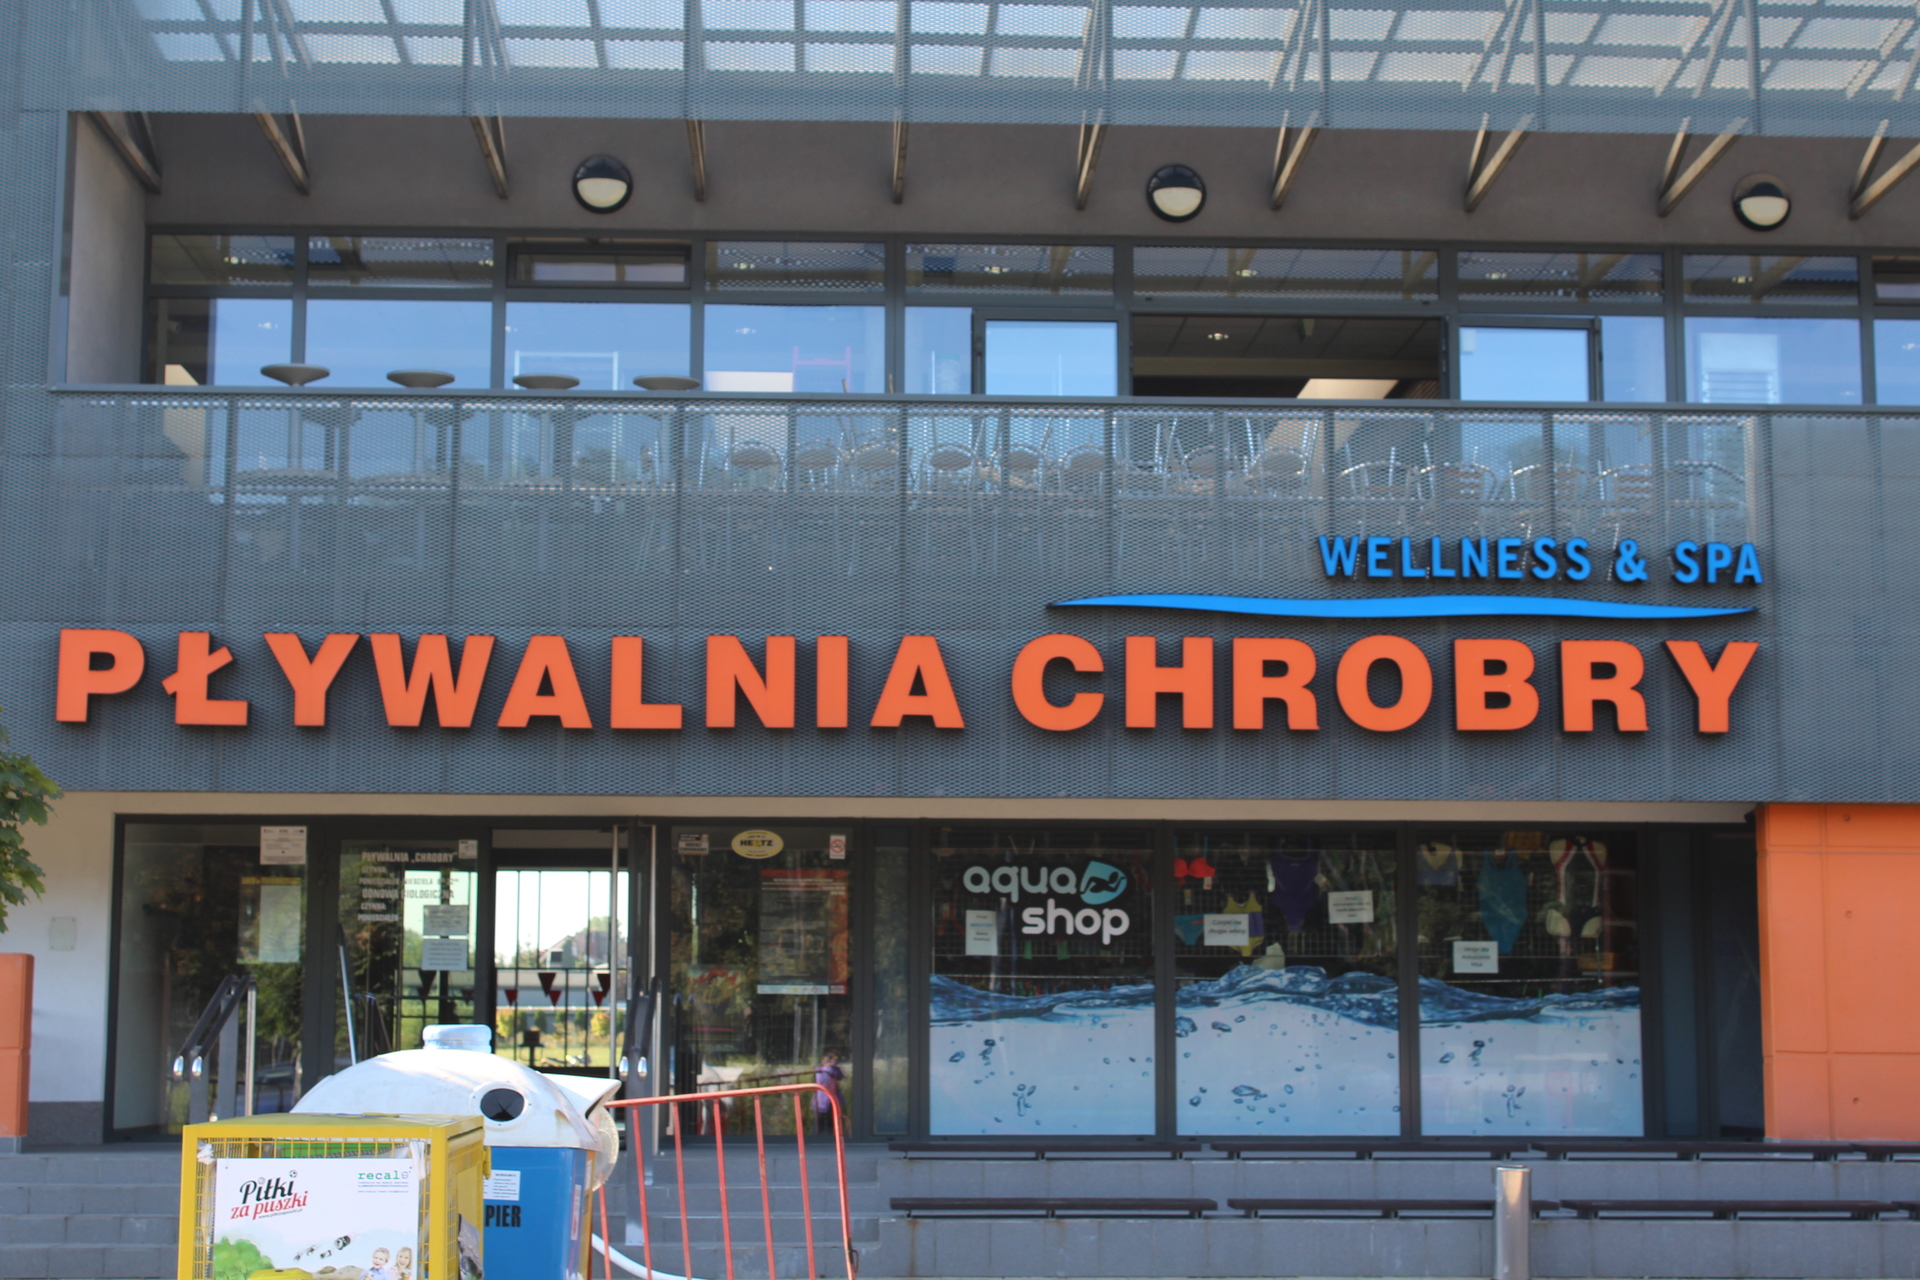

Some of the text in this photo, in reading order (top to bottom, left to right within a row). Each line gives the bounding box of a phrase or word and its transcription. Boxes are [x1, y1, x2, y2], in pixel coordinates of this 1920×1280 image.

[1319, 535, 1764, 584] WELLNESS & SPA
[55, 628, 1760, 733] PŁYWALNIA CHROBRY
[963, 866, 1077, 903] aqua
[1021, 898, 1130, 946] shop
[230, 1190, 309, 1221] za puszki
[239, 1171, 296, 1205] Piłki
